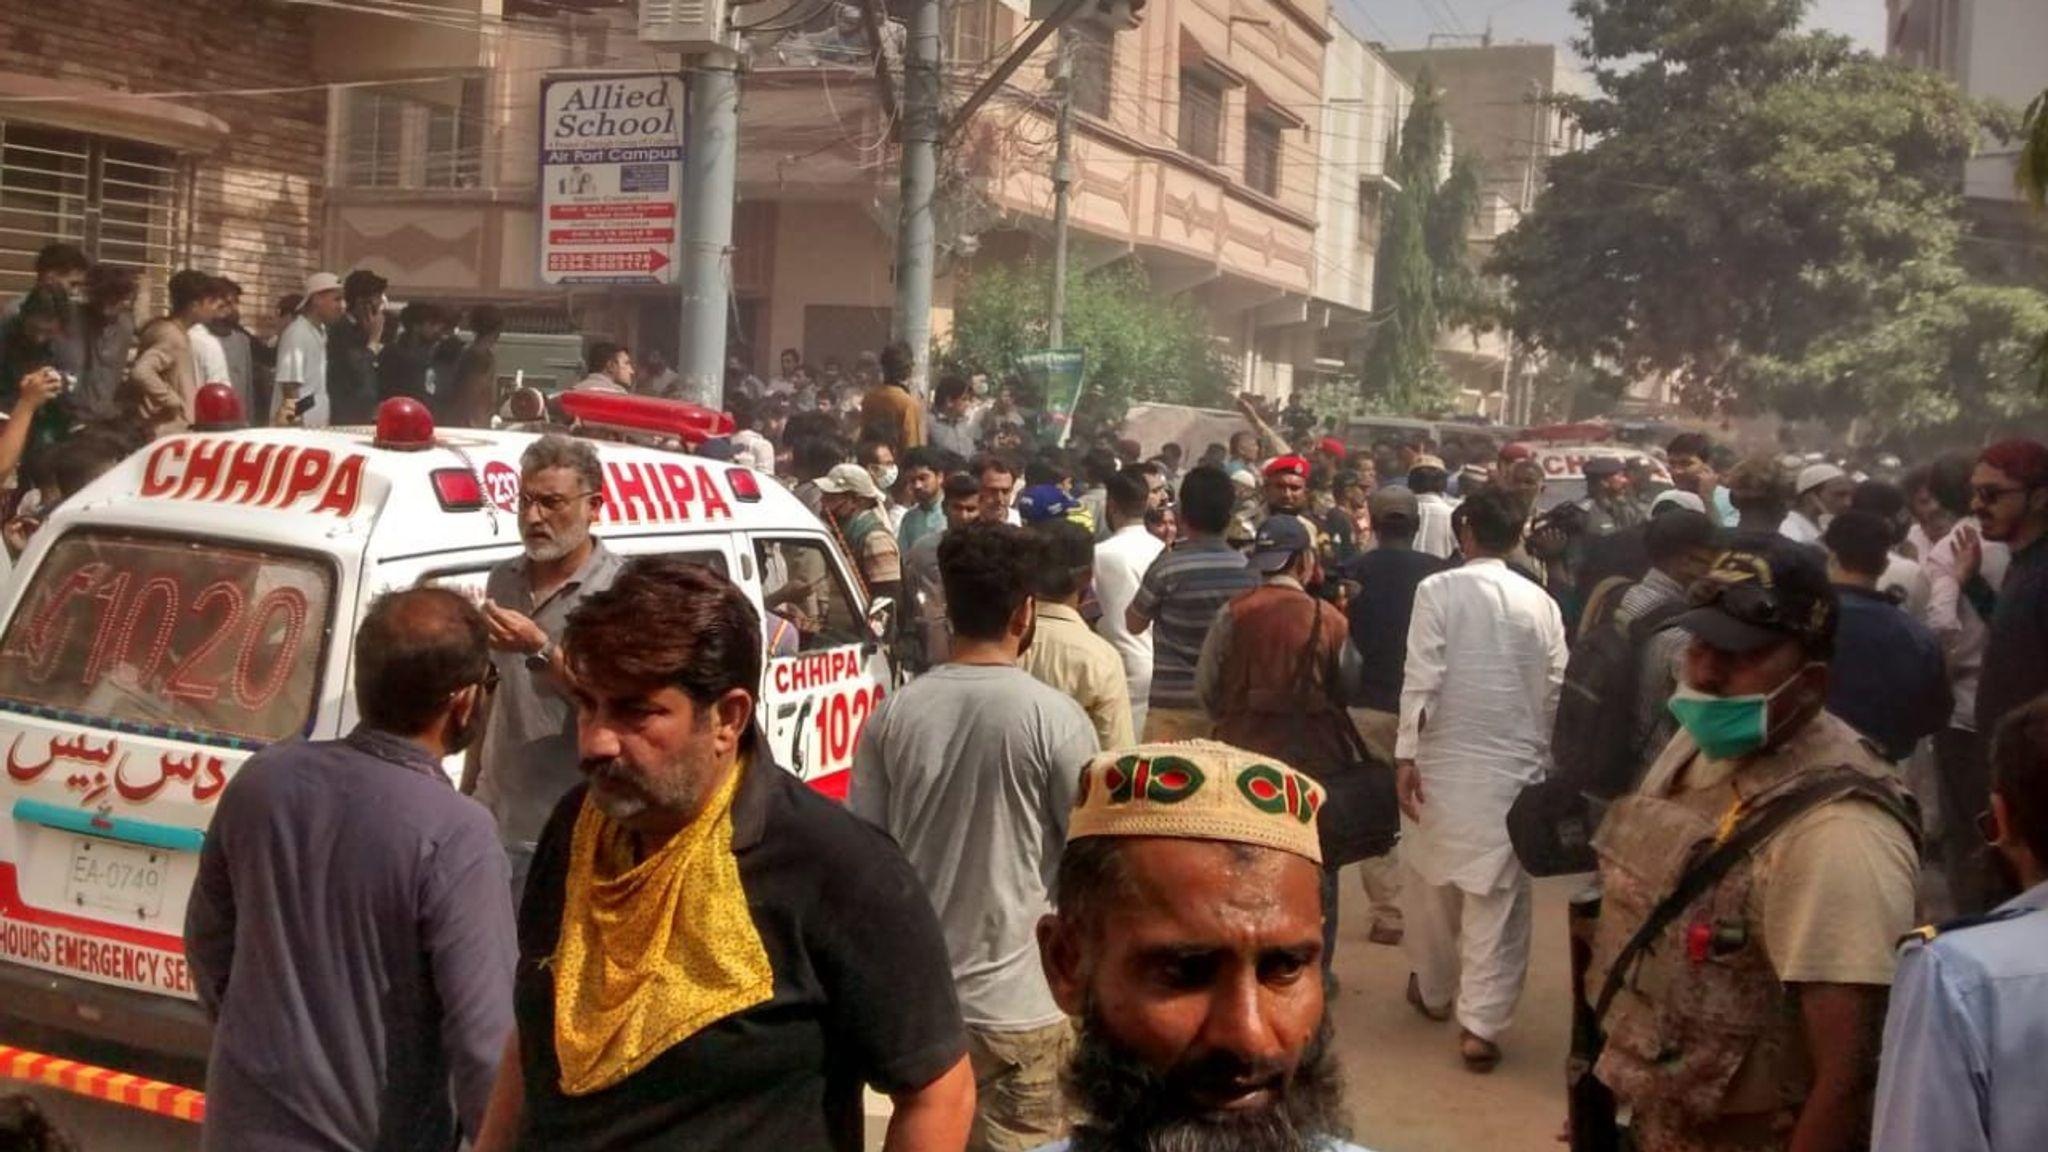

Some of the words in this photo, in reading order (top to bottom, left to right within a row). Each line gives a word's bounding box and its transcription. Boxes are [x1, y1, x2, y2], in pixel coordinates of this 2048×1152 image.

[561, 81, 669, 112] Allied
[556, 109, 674, 137] School
[549, 152, 570, 162] Air
[608, 147, 679, 161] Campus
[140, 438, 367, 517] CHHIPA
[600, 462, 732, 524] HIPA
[775, 650, 860, 694] CHHIPA
[114, 751, 226, 802] دس
[73, 855, 161, 891] EA-0749
[55, 934, 161, 987] EMERGENCY
